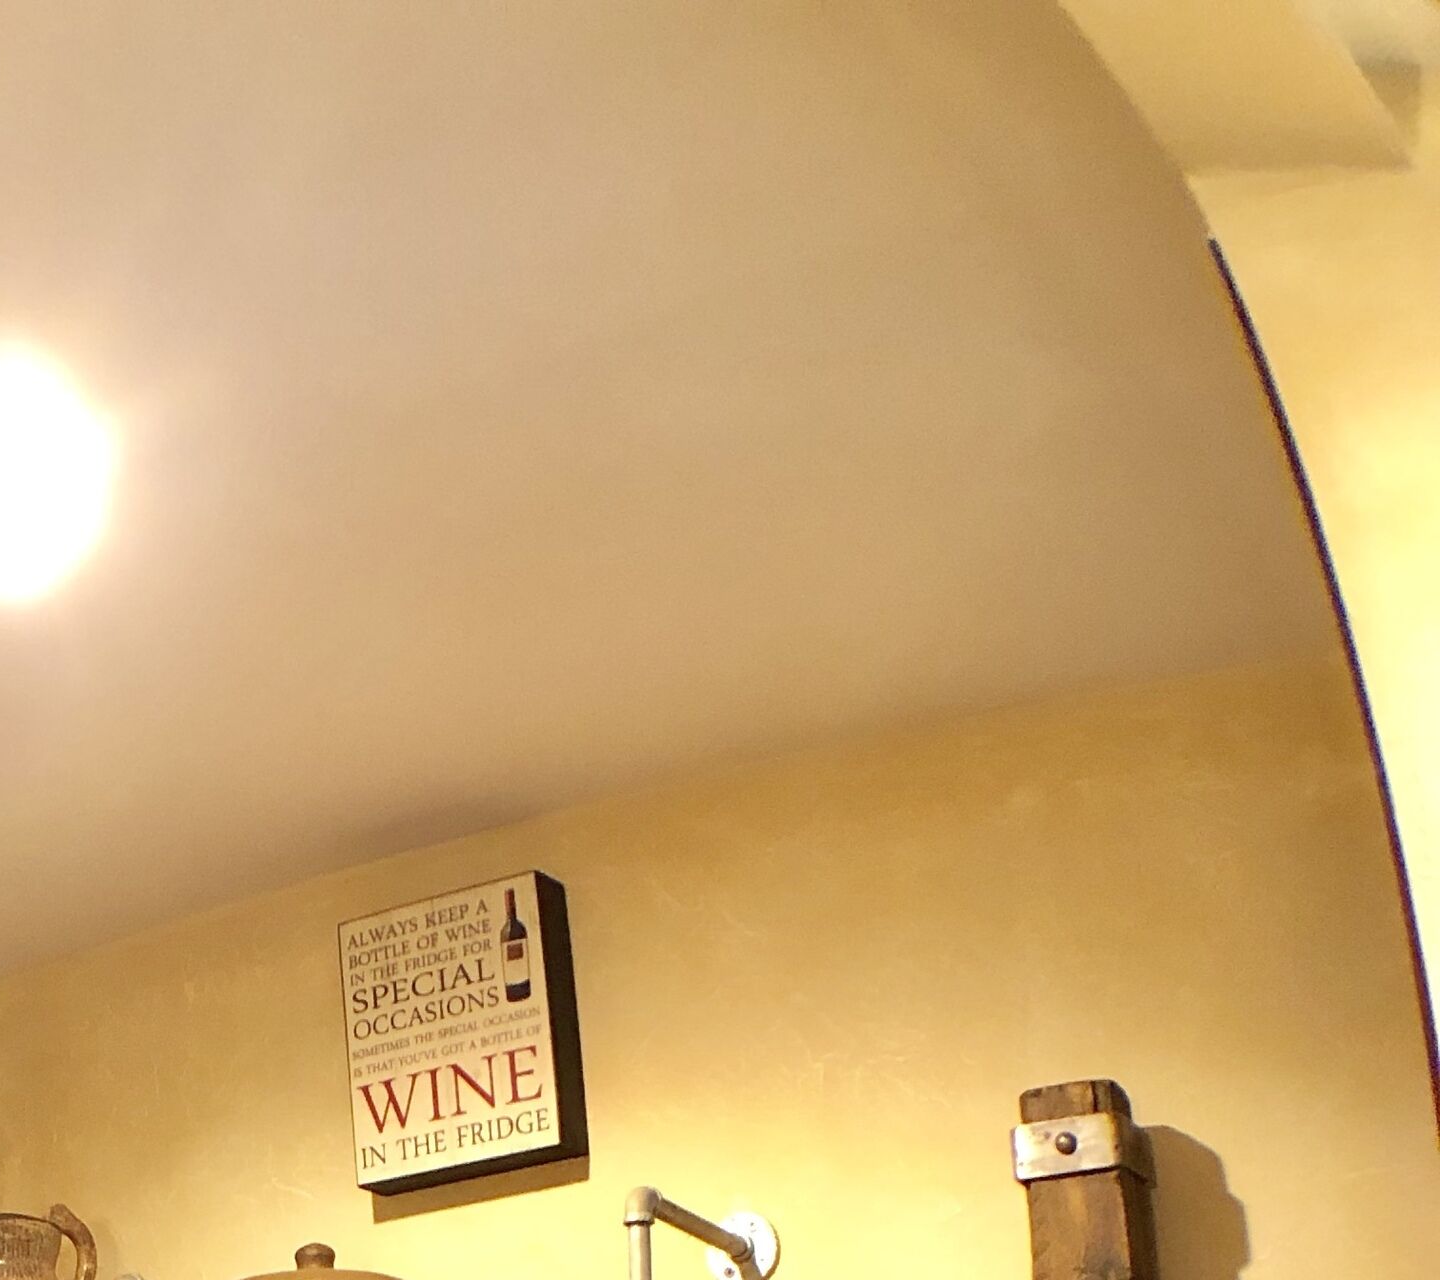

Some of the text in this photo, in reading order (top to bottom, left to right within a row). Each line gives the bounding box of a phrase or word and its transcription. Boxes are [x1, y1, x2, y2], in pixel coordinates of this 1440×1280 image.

[347, 899, 488, 950] ALWAYS KEEP A
[349, 919, 491, 970] BOTTLE OF WINE
[350, 939, 492, 987] IN THE FRIDGE FOR
[352, 958, 495, 1014] SPECIAL
[352, 1006, 540, 1060] SOMETIMES THE SPECIAL OCCASION
[353, 986, 499, 1040] OCCASIONS
[366, 1058, 394, 1074] THAT
[441, 1041, 465, 1056] GOT
[469, 1040, 477, 1050] A
[480, 1028, 522, 1048] BOTTLE
[526, 1024, 542, 1036] OF
[357, 1045, 543, 1134] WINE
[361, 1108, 550, 1170] IN THE FRIDGE
